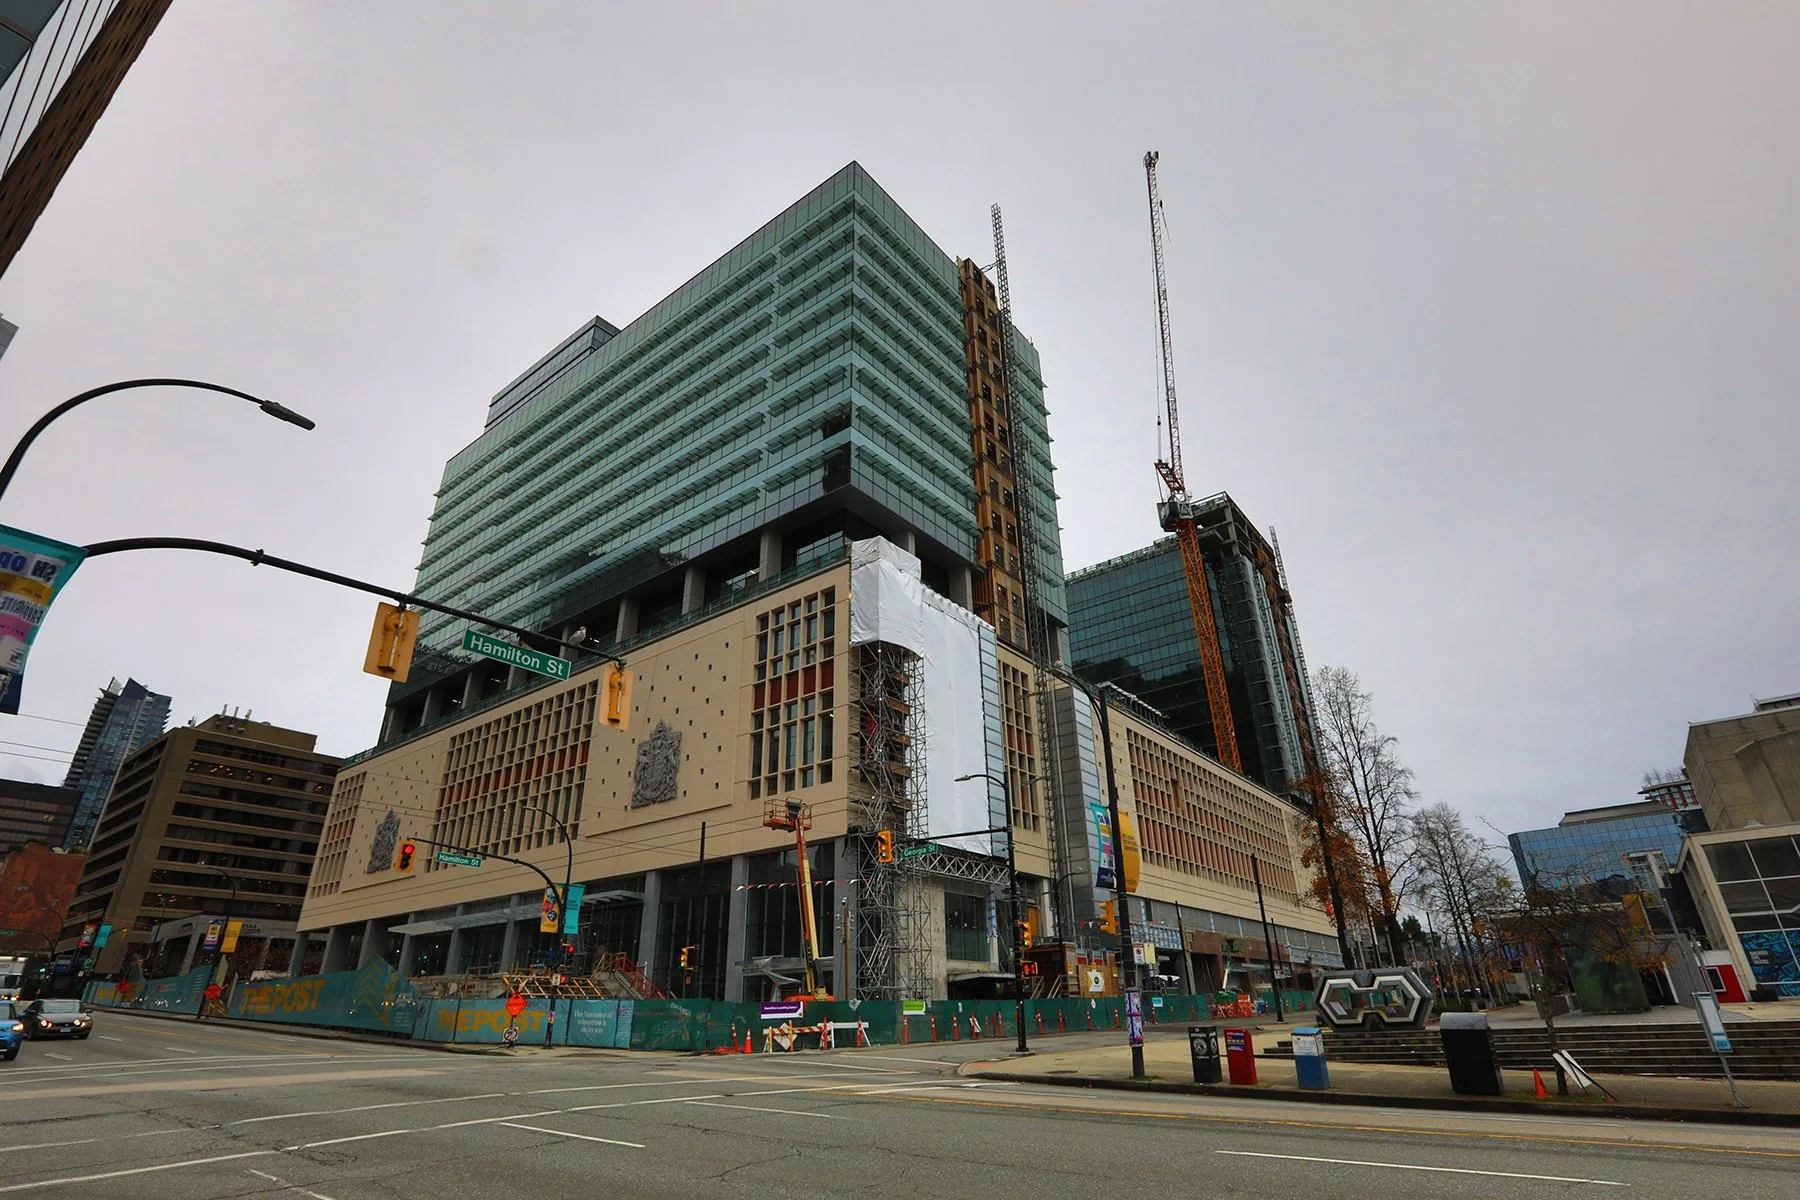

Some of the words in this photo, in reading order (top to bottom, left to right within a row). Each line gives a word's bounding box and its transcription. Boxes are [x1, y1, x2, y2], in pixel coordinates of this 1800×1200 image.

[470, 635, 540, 669] Hamilton
[546, 660, 564, 676] St
[904, 847, 927, 857] Georgia
[928, 845, 936, 853] St
[438, 853, 469, 865] Hamilton
[470, 858, 479, 866] St
